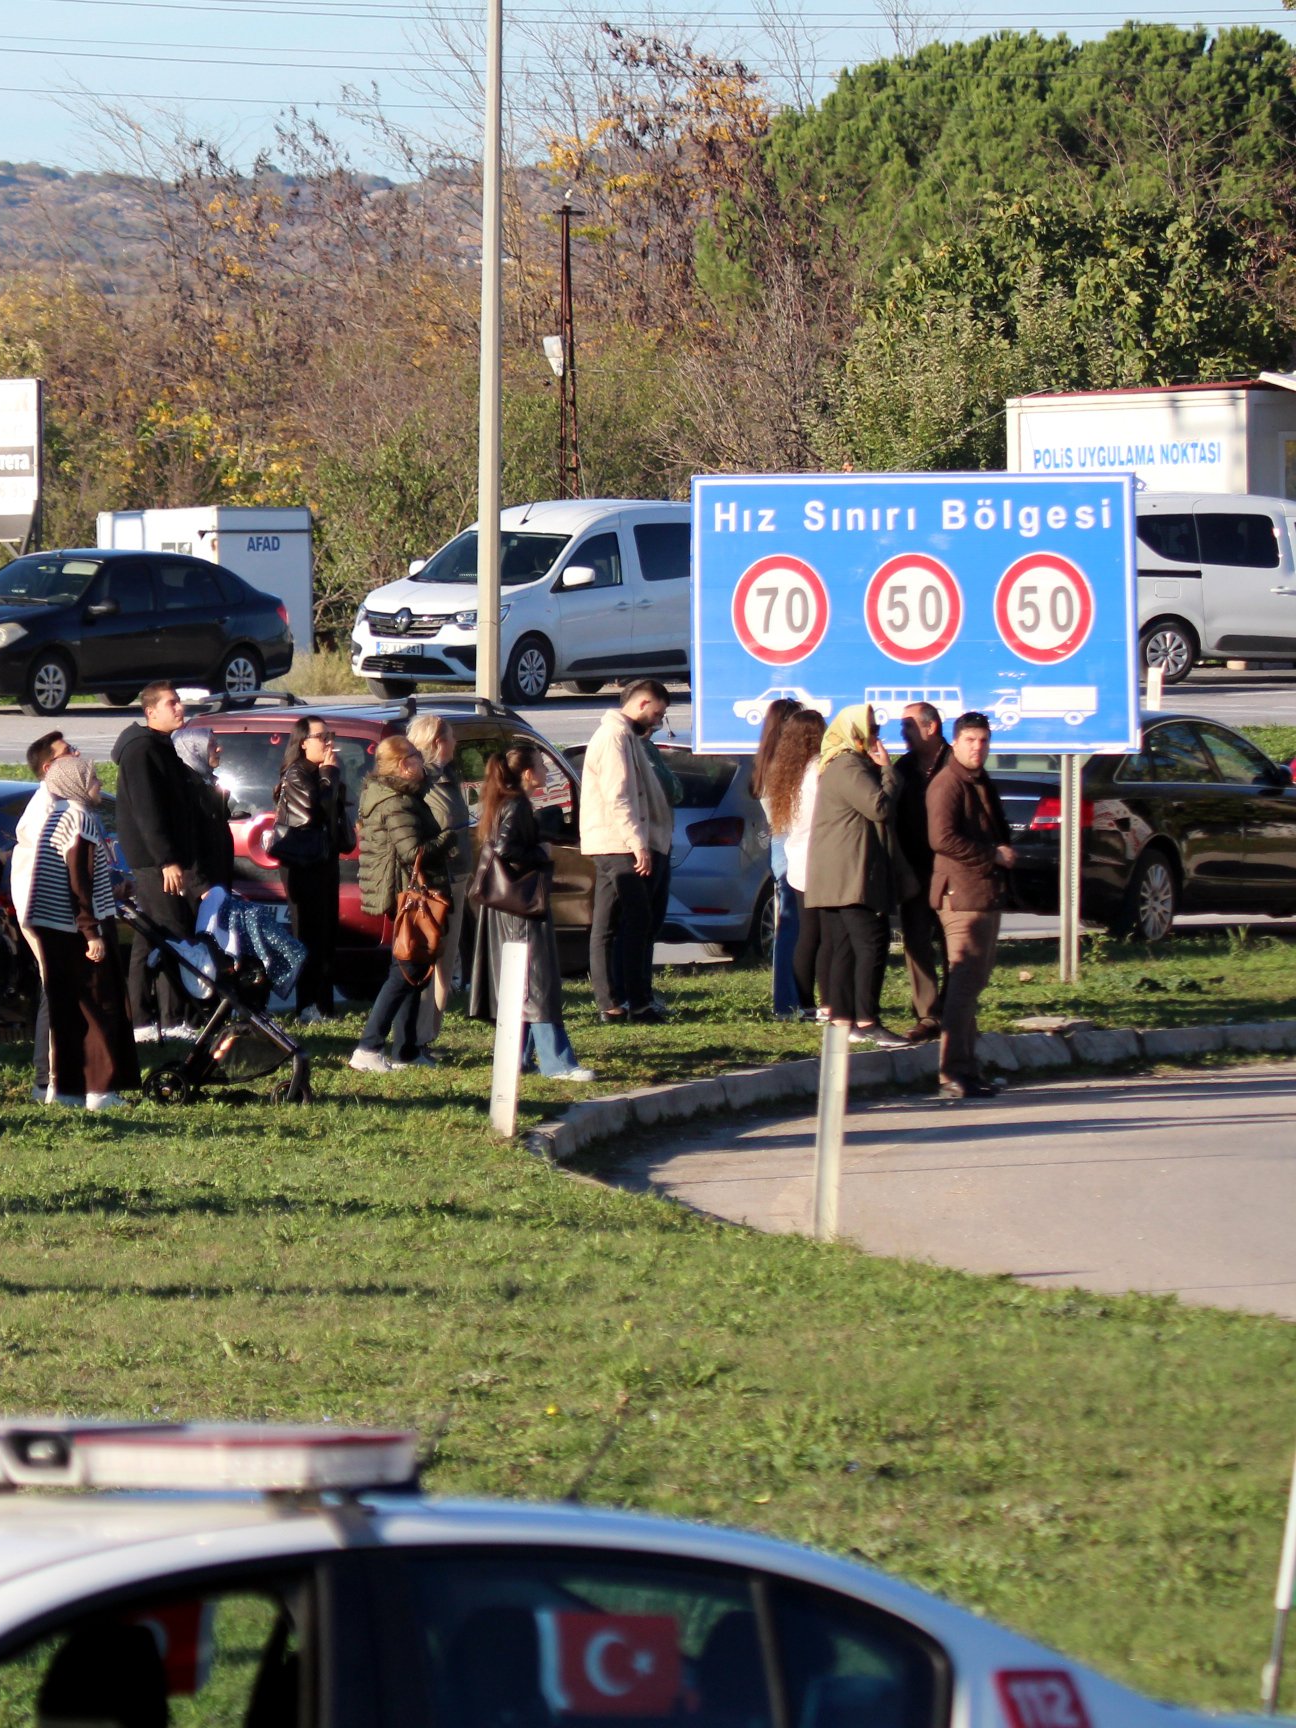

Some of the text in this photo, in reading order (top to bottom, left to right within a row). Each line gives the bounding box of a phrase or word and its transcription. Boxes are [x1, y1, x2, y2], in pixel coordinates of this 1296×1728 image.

[1078, 445, 1154, 468] UYGULAMA
[1160, 442, 1221, 465] NOKTASI
[714, 499, 1112, 538] Hız Sınırı Bölgesi
[247, 536, 280, 552] AFAD
[756, 586, 810, 634] 70
[886, 585, 943, 633] 50
[1017, 585, 1074, 633] 50
[1008, 1679, 1080, 1728] 112
